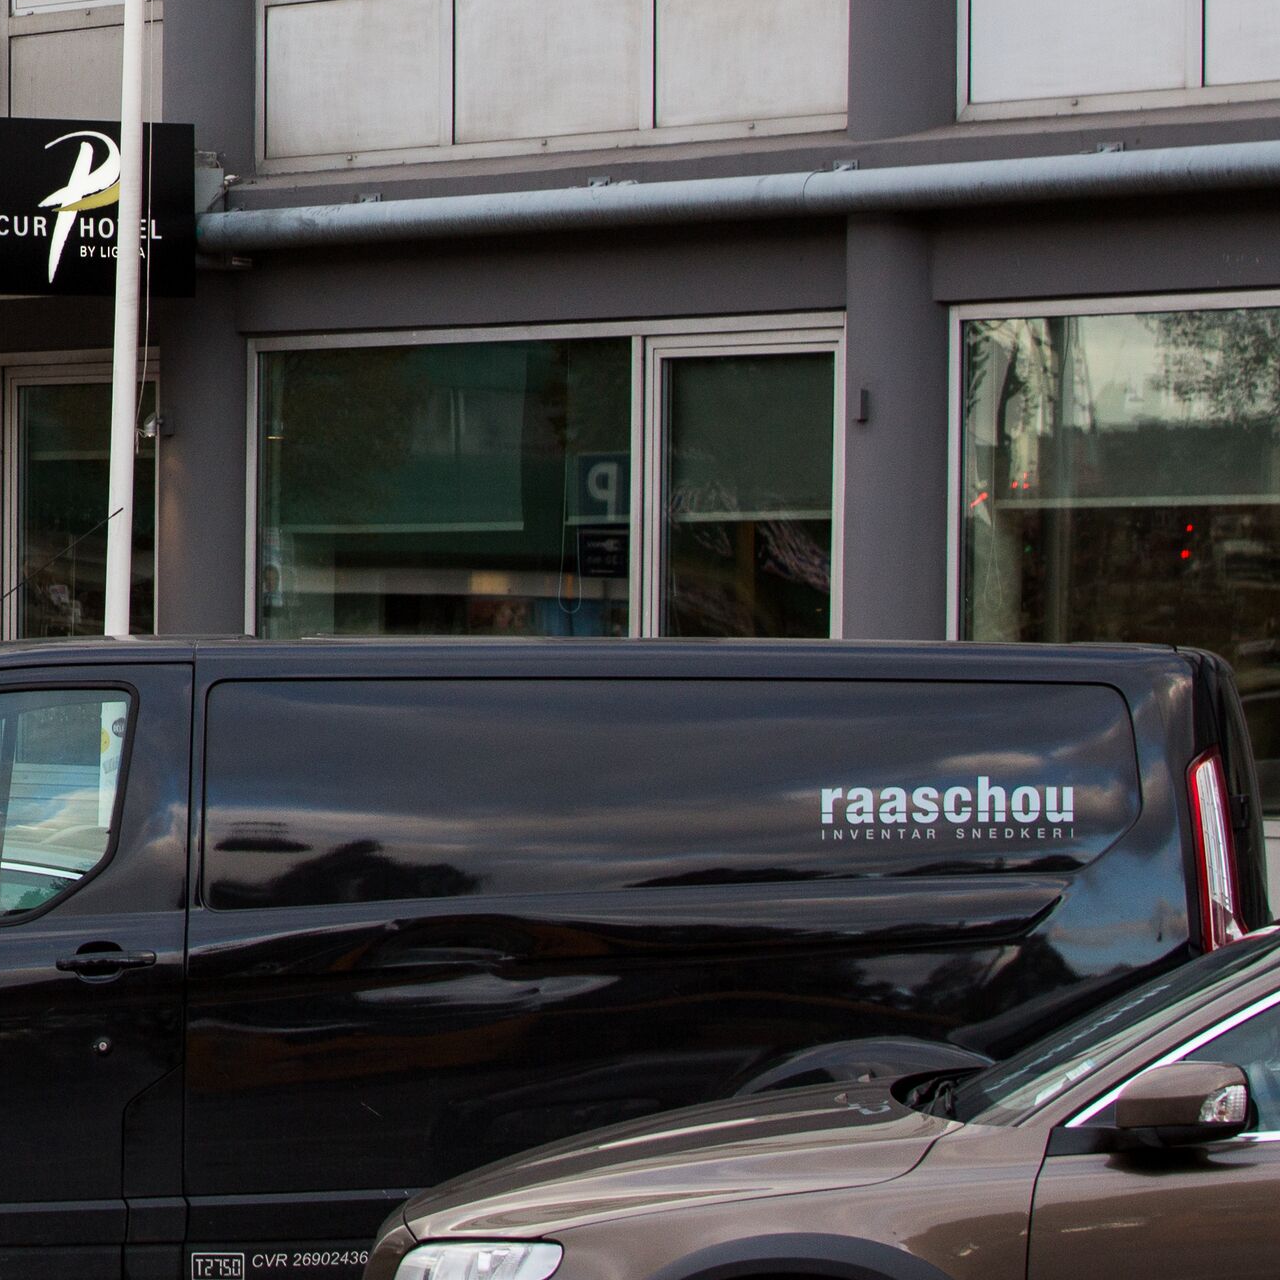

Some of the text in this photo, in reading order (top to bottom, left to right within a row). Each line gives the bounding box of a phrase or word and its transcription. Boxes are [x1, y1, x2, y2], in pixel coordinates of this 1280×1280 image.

[80, 217, 162, 240] HOEL
[81, 246, 95, 257] BY
[822, 777, 1073, 824] raaschou
[821, 827, 1075, 840] INVENTAR SNEDKERI
[253, 1251, 368, 1267] CVR 26902436
